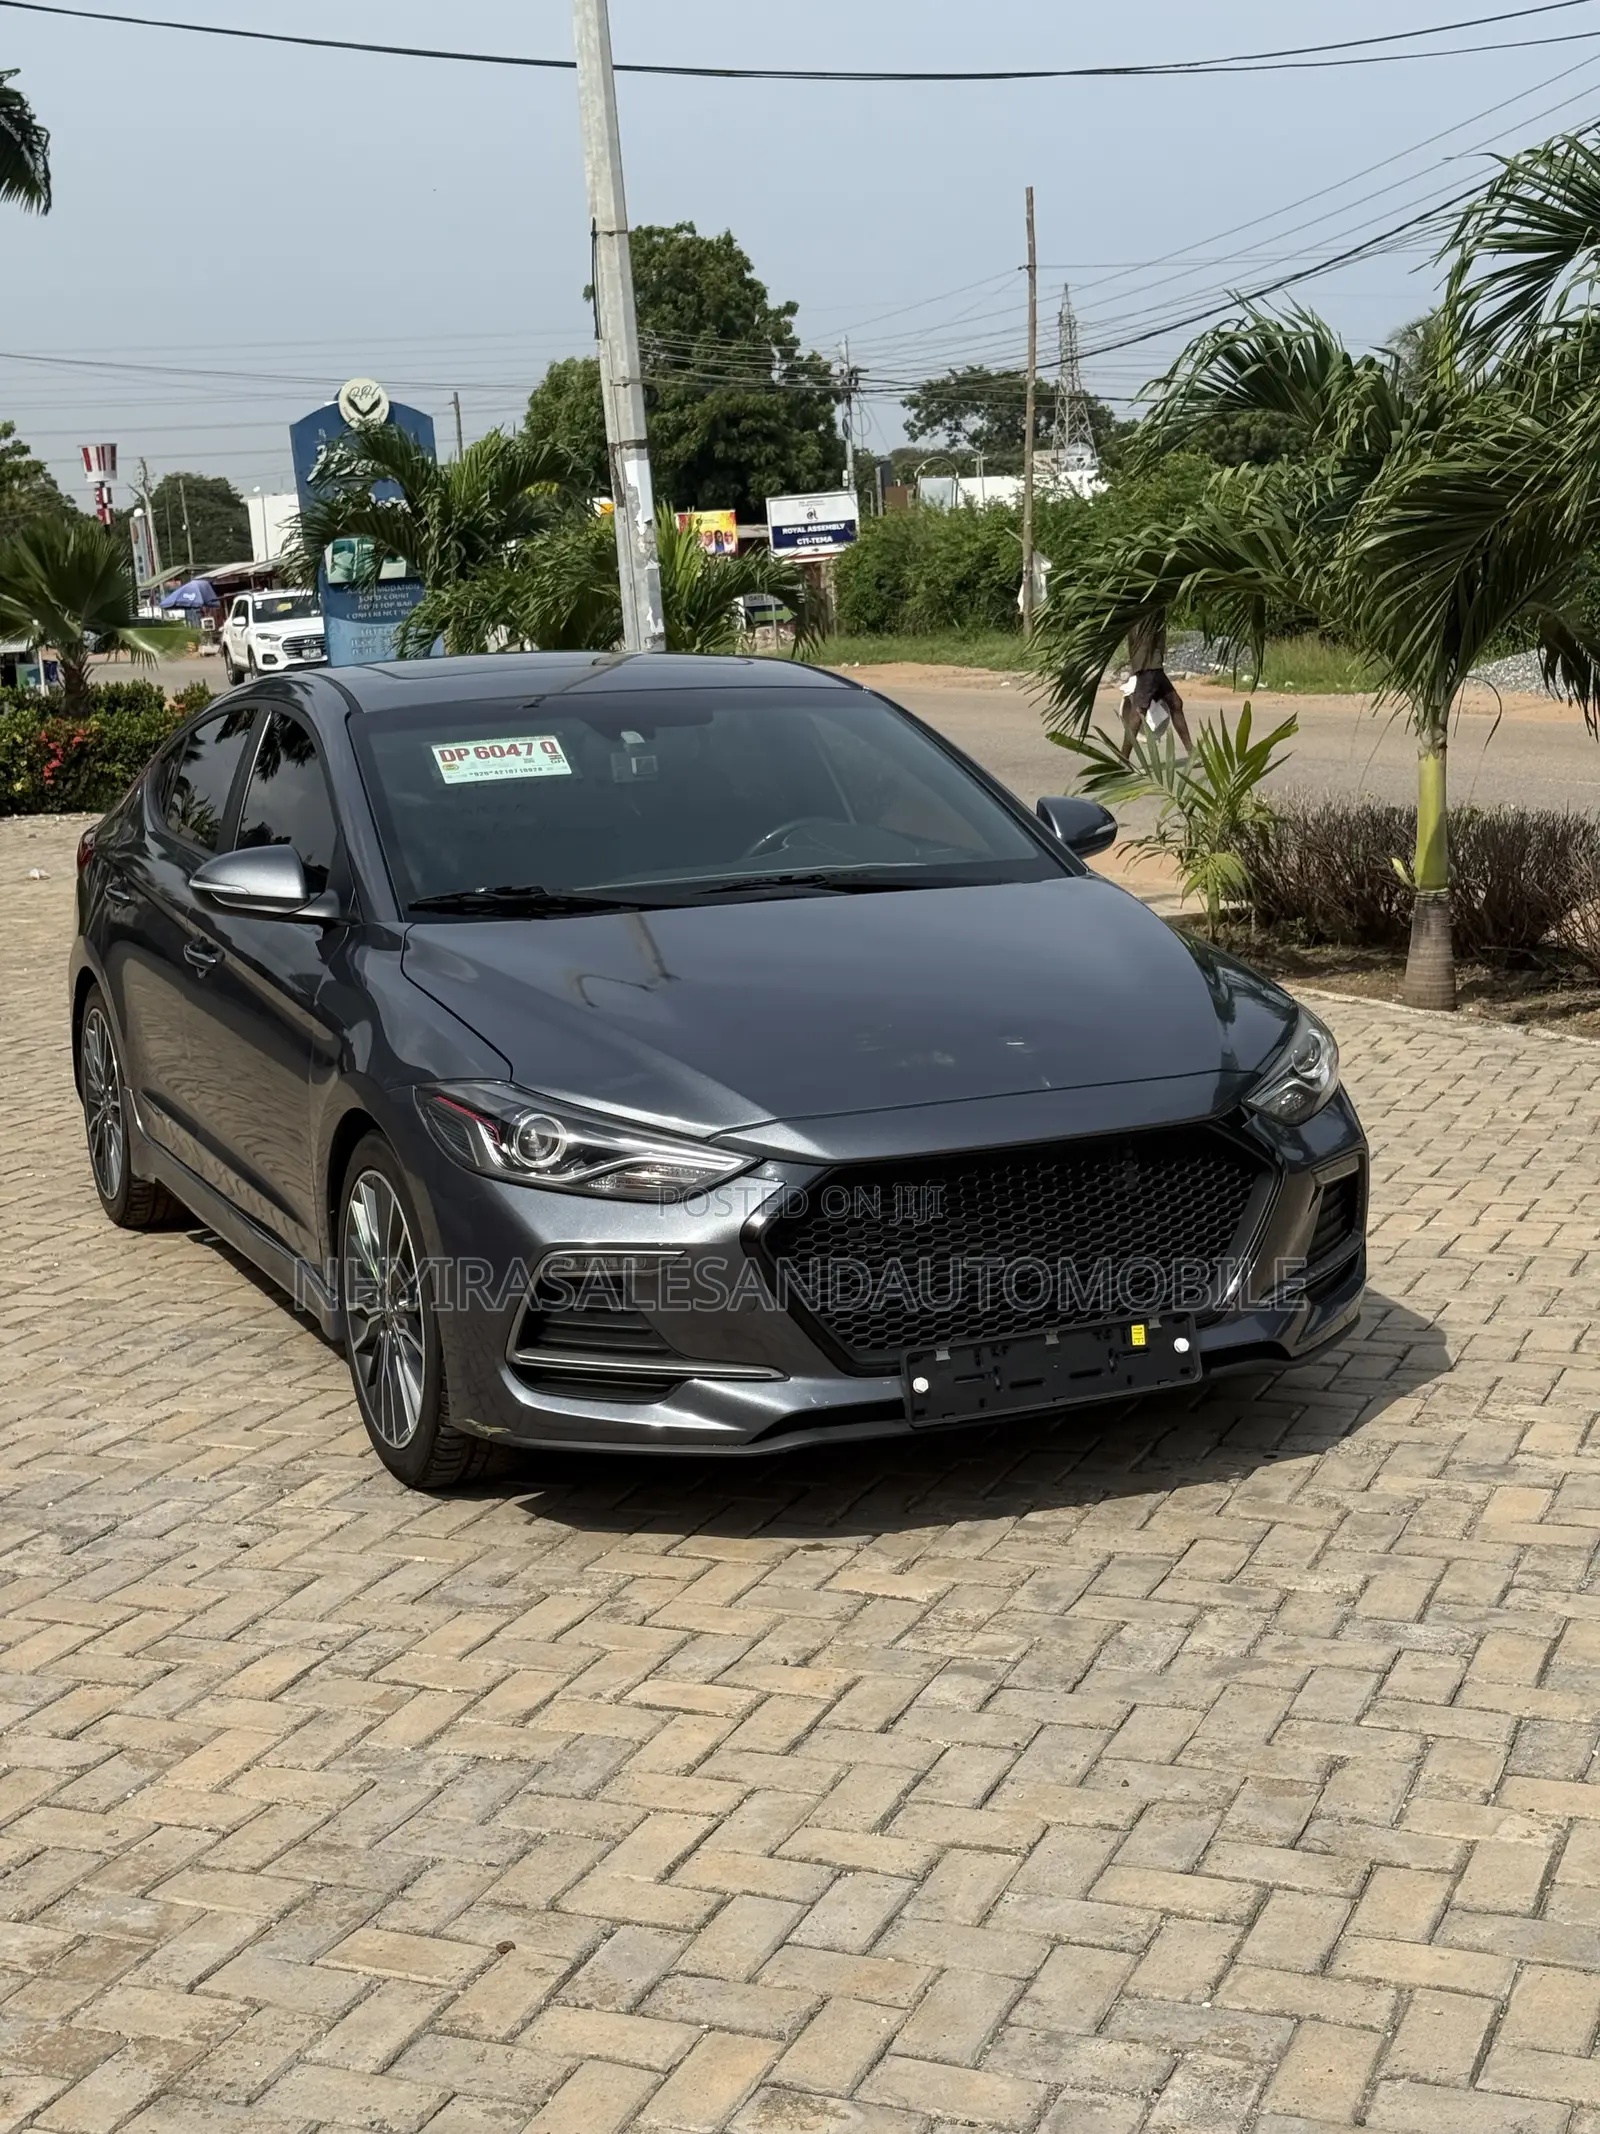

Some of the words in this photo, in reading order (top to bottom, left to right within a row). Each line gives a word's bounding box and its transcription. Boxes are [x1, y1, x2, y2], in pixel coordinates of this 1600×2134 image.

[782, 526, 806, 535] ROYAL
[807, 523, 846, 533] ASSEMBLY
[438, 748, 470, 762] DP
[473, 743, 533, 759] 6047
[540, 741, 560, 755] Q
